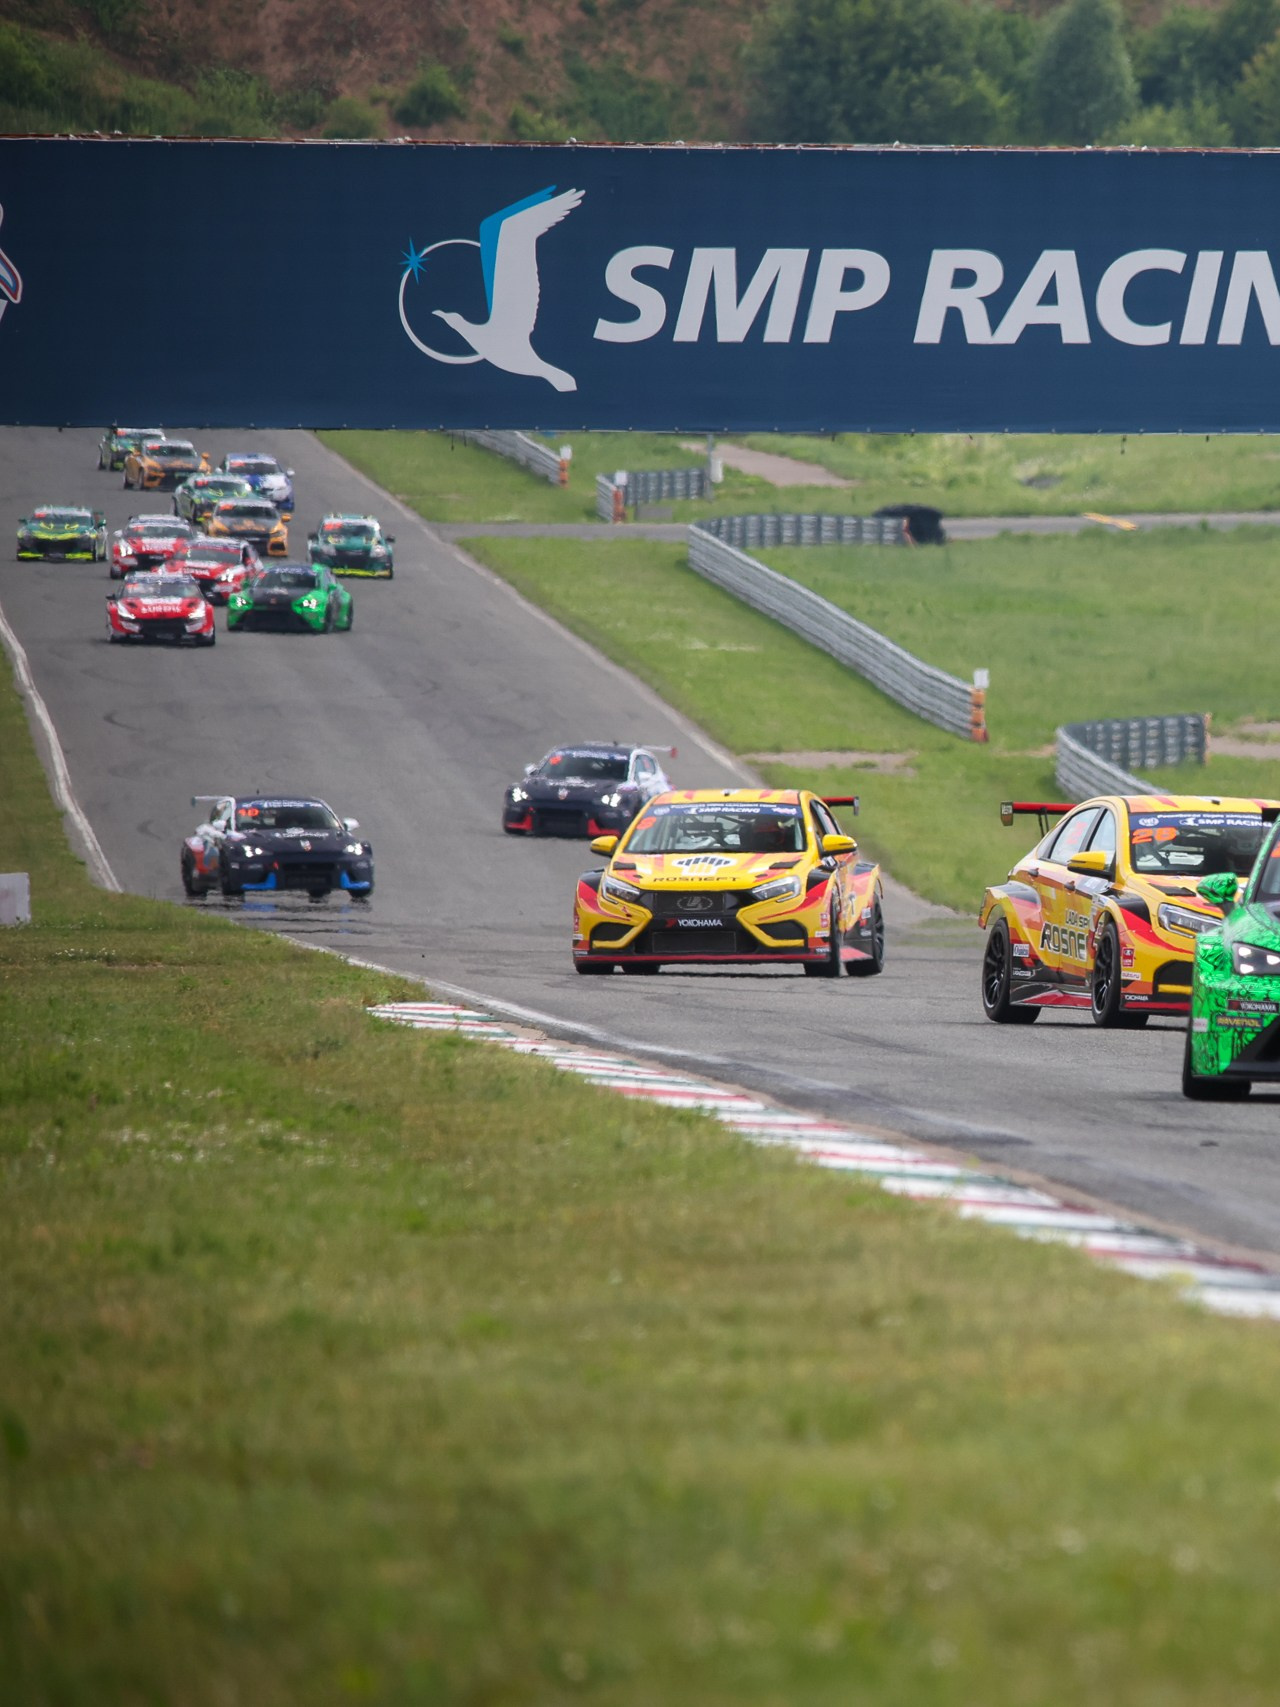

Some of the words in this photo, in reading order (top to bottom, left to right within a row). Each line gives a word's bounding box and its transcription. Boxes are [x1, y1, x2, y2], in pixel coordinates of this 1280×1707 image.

[593, 245, 891, 344] SMP
[1226, 819, 1273, 828] RACING
[1131, 826, 1177, 845] 28
[677, 918, 723, 928] YOKOHAMA
[1039, 921, 1092, 962] ROSNE
[1240, 1001, 1278, 1012] YOKOHAMA
[1216, 1016, 1262, 1028] RAVENOL
